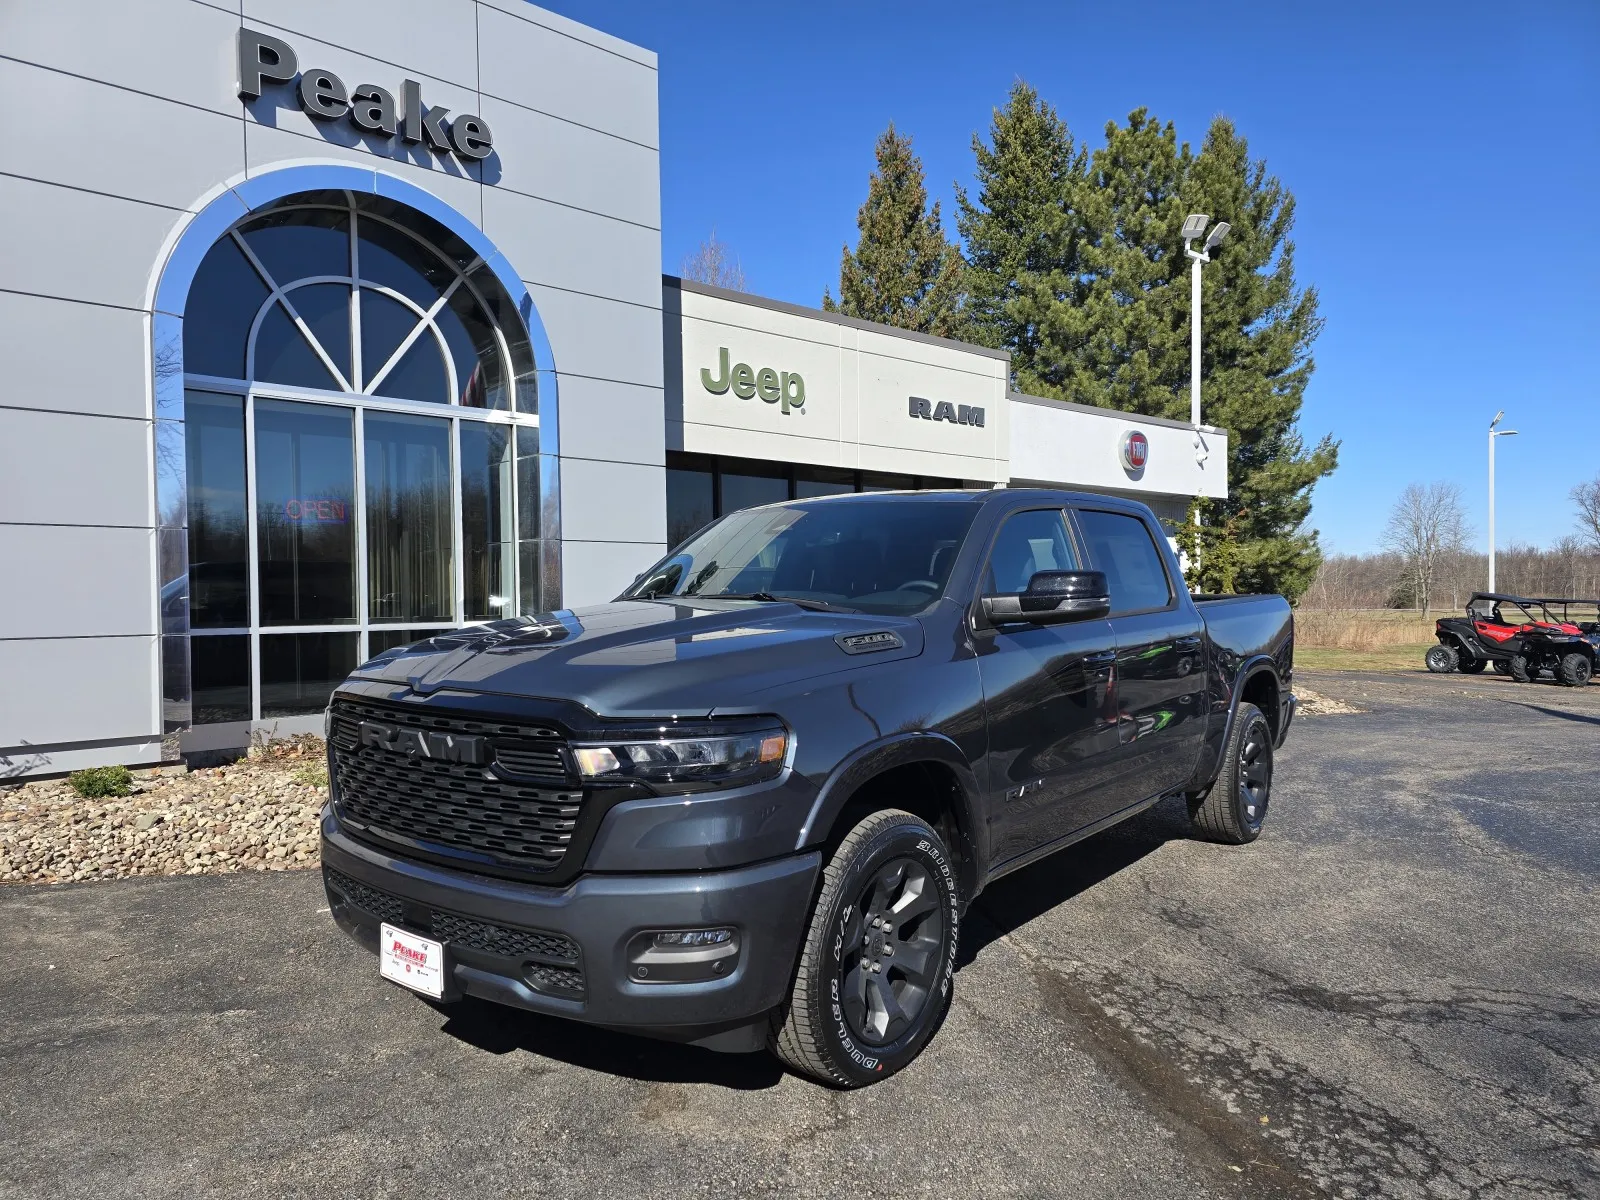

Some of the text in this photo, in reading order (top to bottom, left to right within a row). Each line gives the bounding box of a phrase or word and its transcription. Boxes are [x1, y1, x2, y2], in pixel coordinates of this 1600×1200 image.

[236, 27, 493, 161] Peake
[700, 347, 806, 415] Jeep
[908, 396, 986, 428] RAM
[286, 499, 344, 520] OPEN
[844, 634, 891, 647] 1500
[358, 720, 490, 765] RAM
[916, 840, 959, 997] BRIDGESTONE
[393, 941, 427, 964] PEAKE
[830, 978, 878, 1071] DUELER
